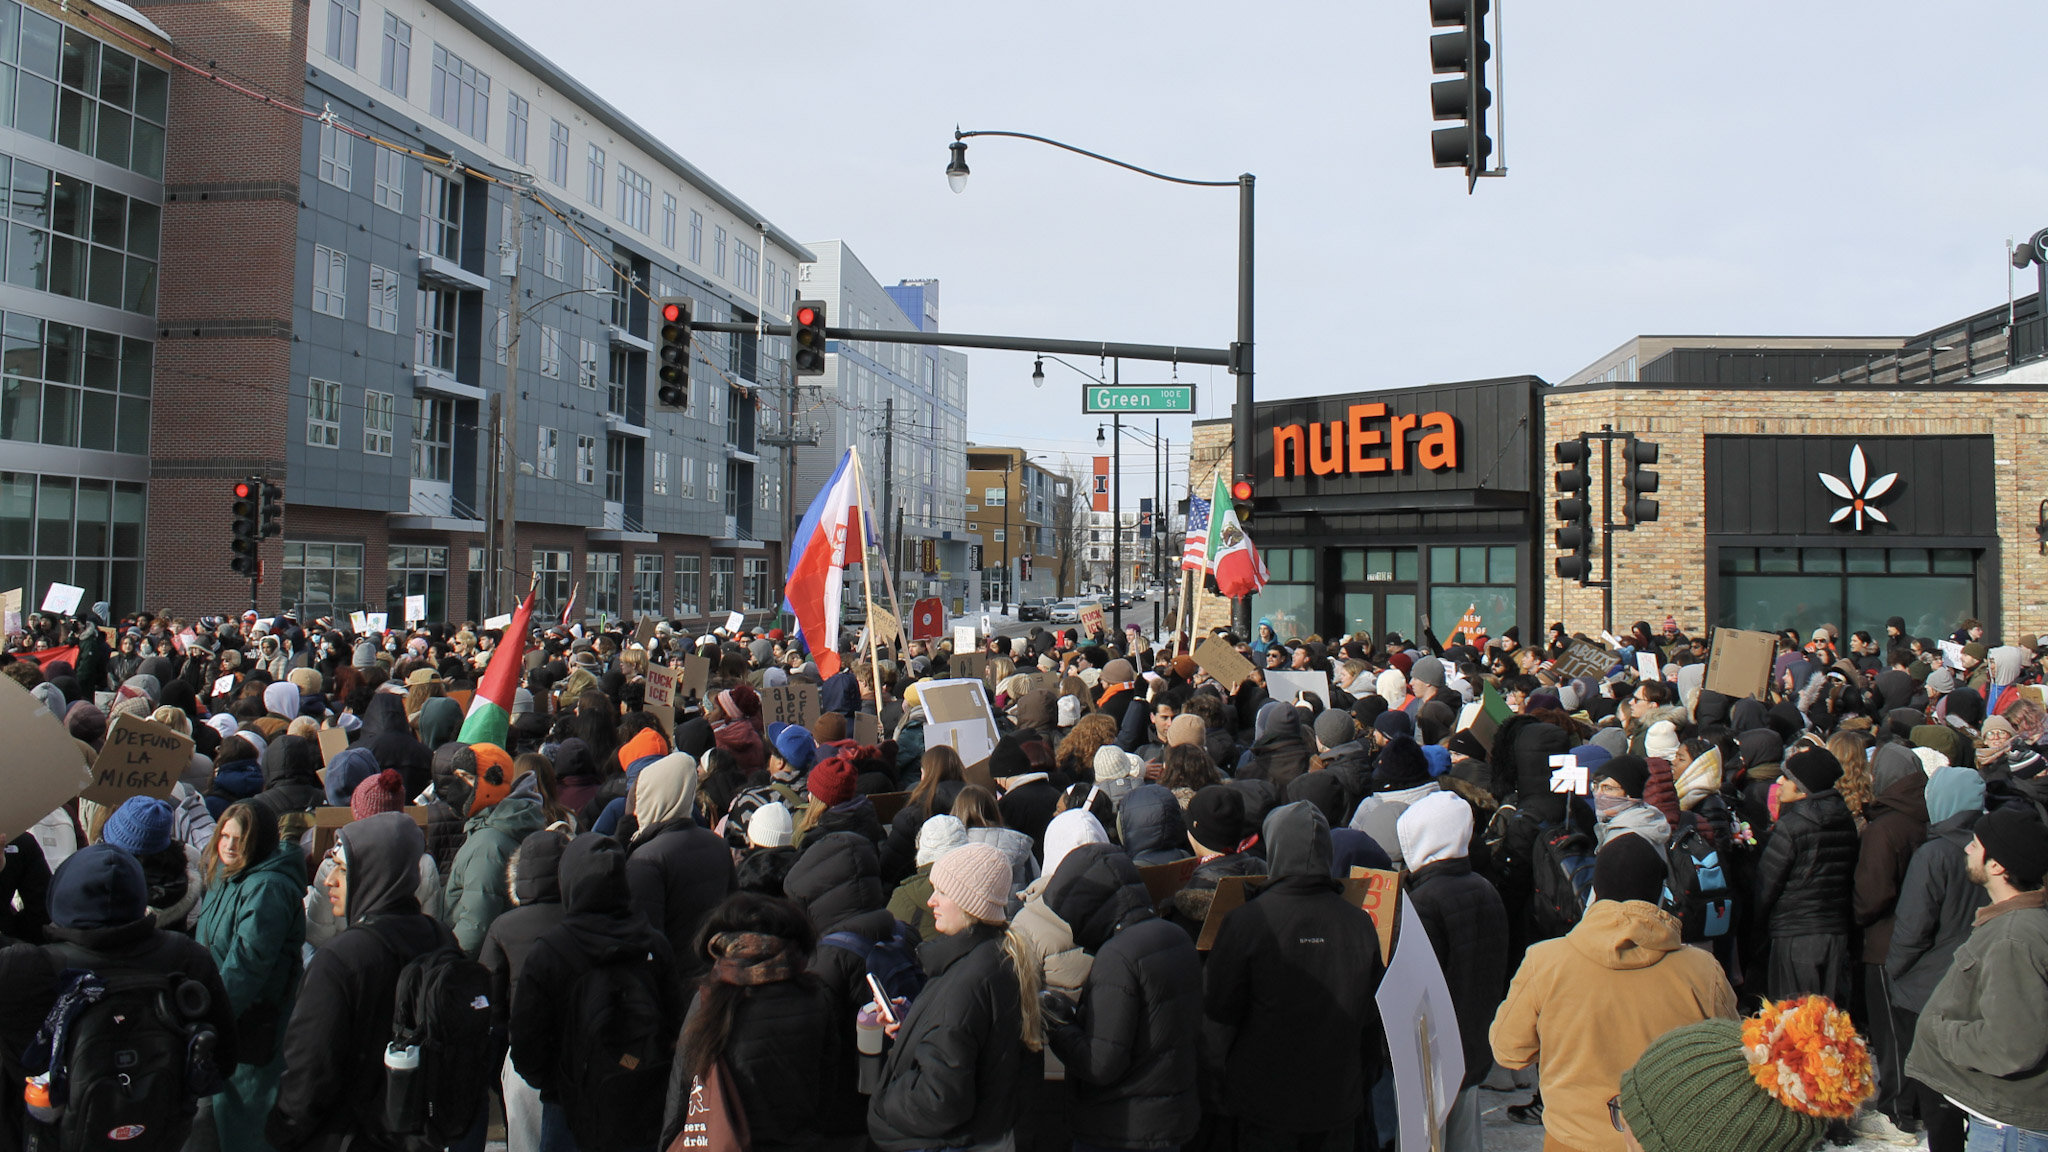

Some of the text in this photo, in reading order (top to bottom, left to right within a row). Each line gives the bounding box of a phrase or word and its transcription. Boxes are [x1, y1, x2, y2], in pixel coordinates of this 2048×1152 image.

[1097, 389, 1151, 409] Green
[1161, 390, 1182, 398] 100 E
[1166, 400, 1176, 408] St
[1273, 403, 1456, 477] nuEra
[1095, 475, 1107, 493] I
[1082, 610, 1102, 624] FUCK
[1557, 655, 1598, 678] ICE
[648, 671, 673, 688] FUCK
[649, 686, 668, 702] ICE!
[114, 728, 180, 750] DEFUND
[127, 751, 152, 764] LA
[98, 769, 169, 788] MIGRA
[684, 1122, 706, 1132] sera
